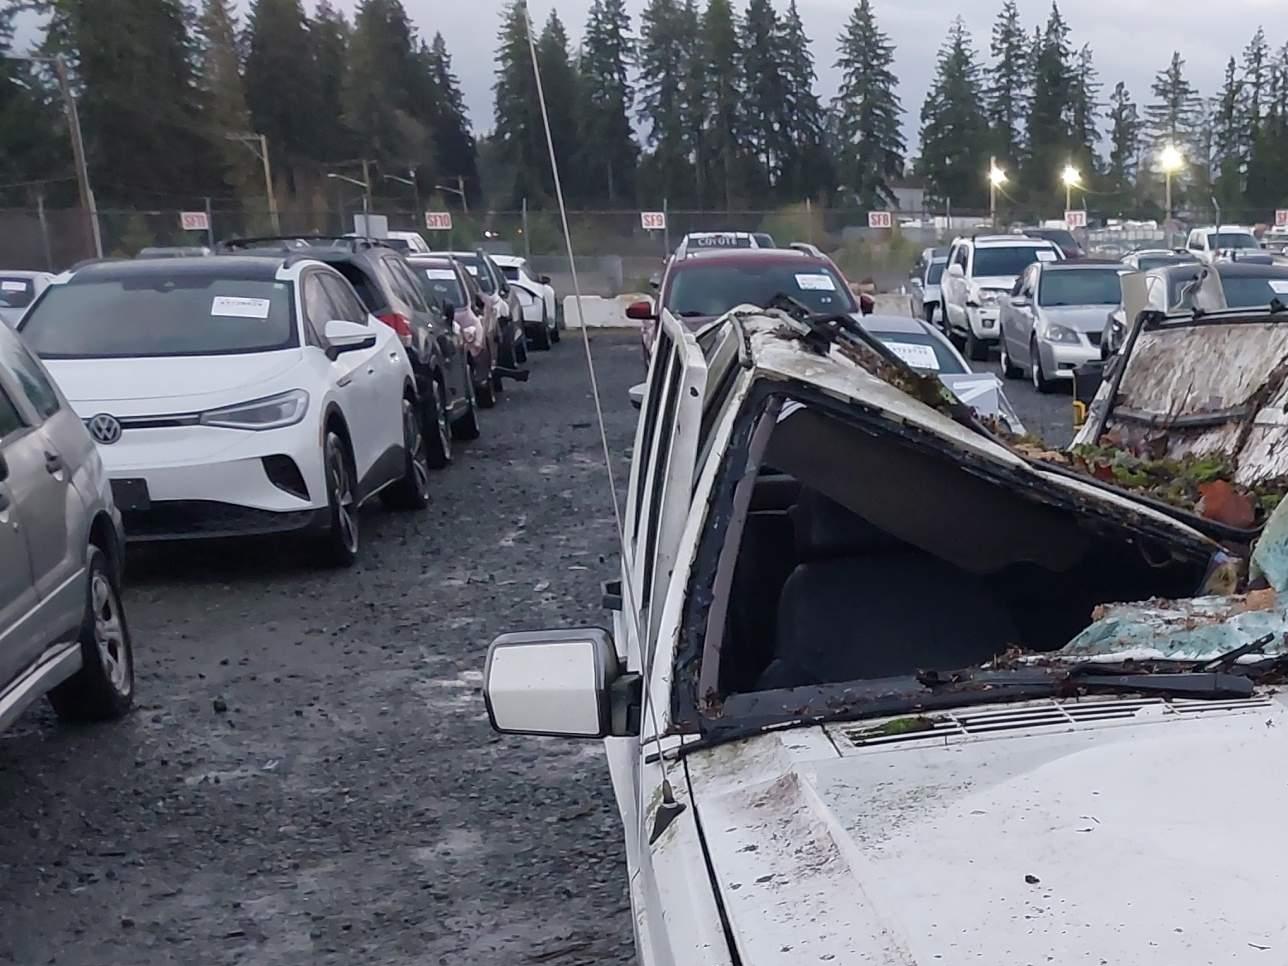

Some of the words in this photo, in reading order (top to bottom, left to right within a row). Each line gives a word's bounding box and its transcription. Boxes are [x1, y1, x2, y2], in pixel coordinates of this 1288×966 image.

[428, 214, 450, 227] SF10
[643, 214, 664, 226] SF9
[871, 214, 889, 226] SF8
[698, 237, 737, 247] COYOTE
